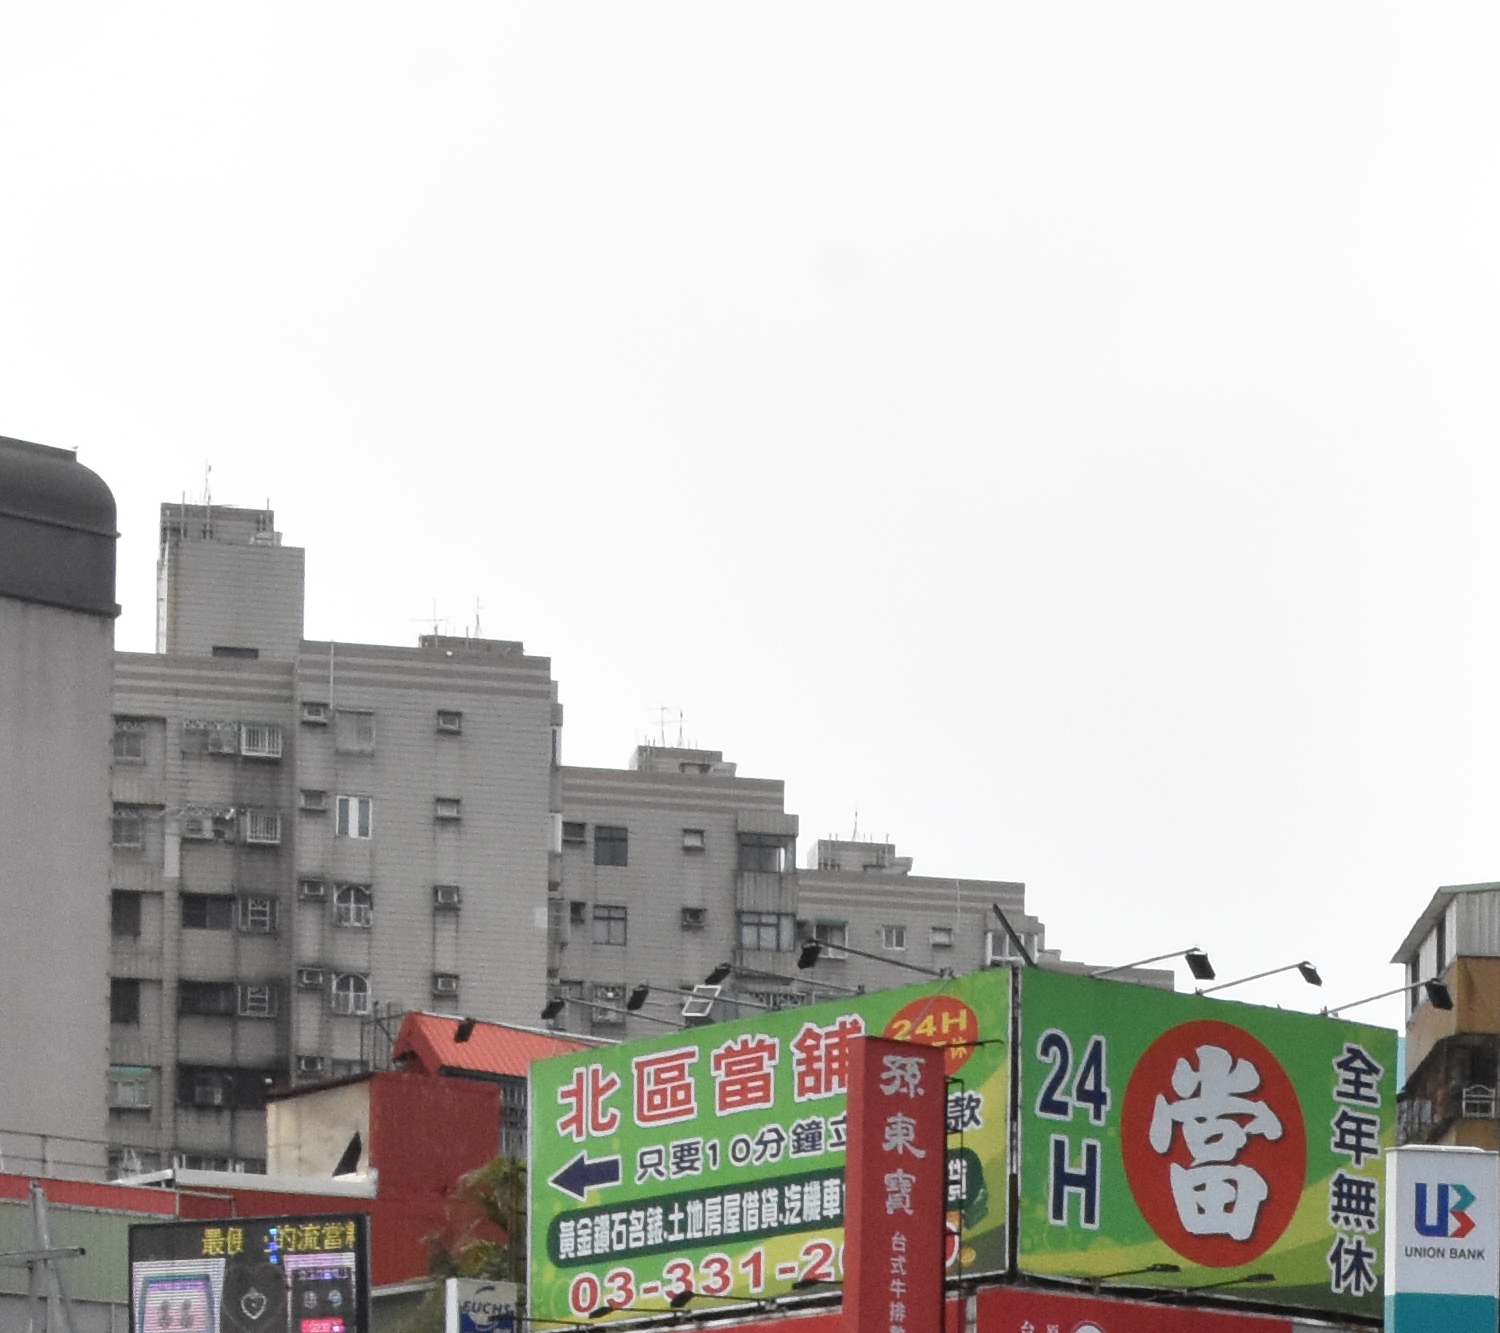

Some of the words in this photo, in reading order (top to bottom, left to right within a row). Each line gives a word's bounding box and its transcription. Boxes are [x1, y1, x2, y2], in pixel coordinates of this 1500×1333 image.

[891, 1008, 968, 1042] 24H
[556, 1013, 866, 1143] 北區當舖
[1035, 1026, 1112, 1127] 24
[1046, 1136, 1102, 1232] H
[1148, 1043, 1284, 1243] 當
[1329, 1043, 1383, 1299] 全年無休
[1404, 1245, 1446, 1259] UNION
[1449, 1248, 1486, 1261] BANK
